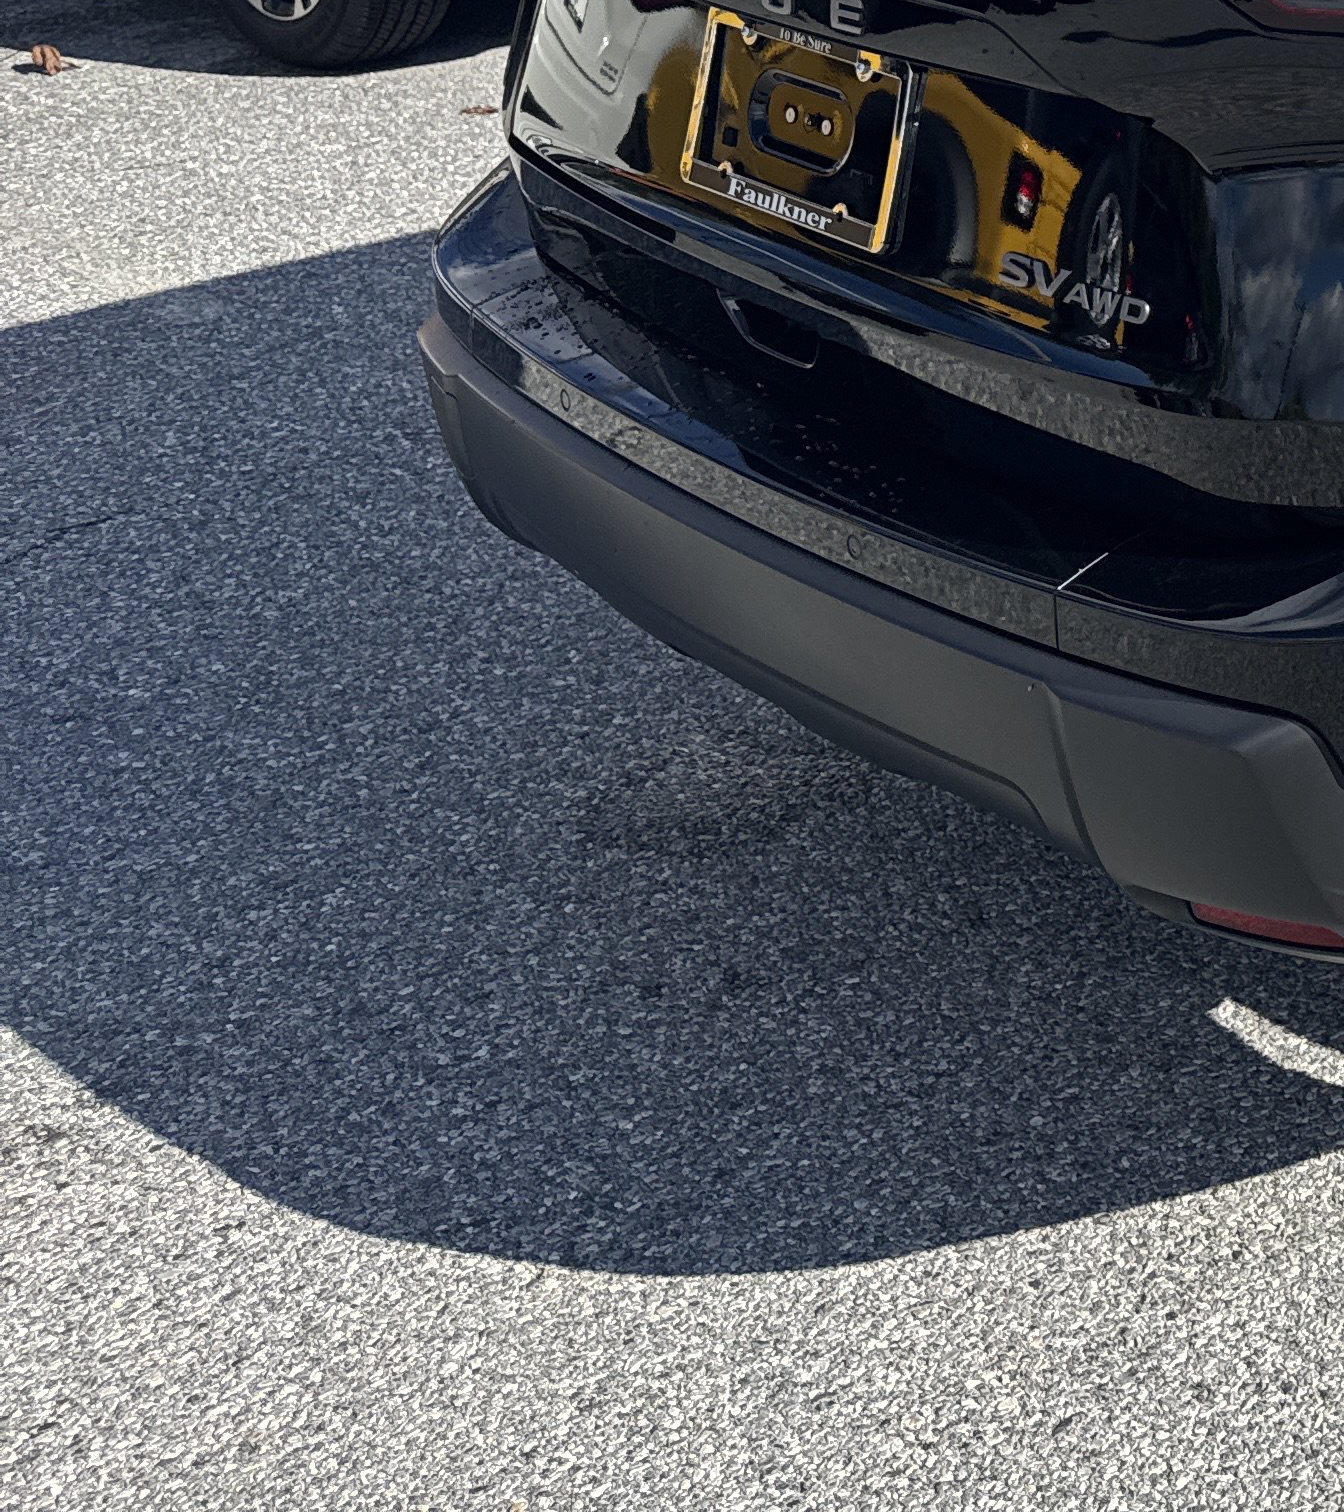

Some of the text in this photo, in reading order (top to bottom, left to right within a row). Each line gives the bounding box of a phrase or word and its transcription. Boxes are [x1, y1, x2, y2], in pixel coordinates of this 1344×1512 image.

[793, 29, 806, 46] Be
[807, 35, 832, 54] Sure
[726, 175, 833, 232] Faulkner
[998, 250, 1151, 326] SV AWD
